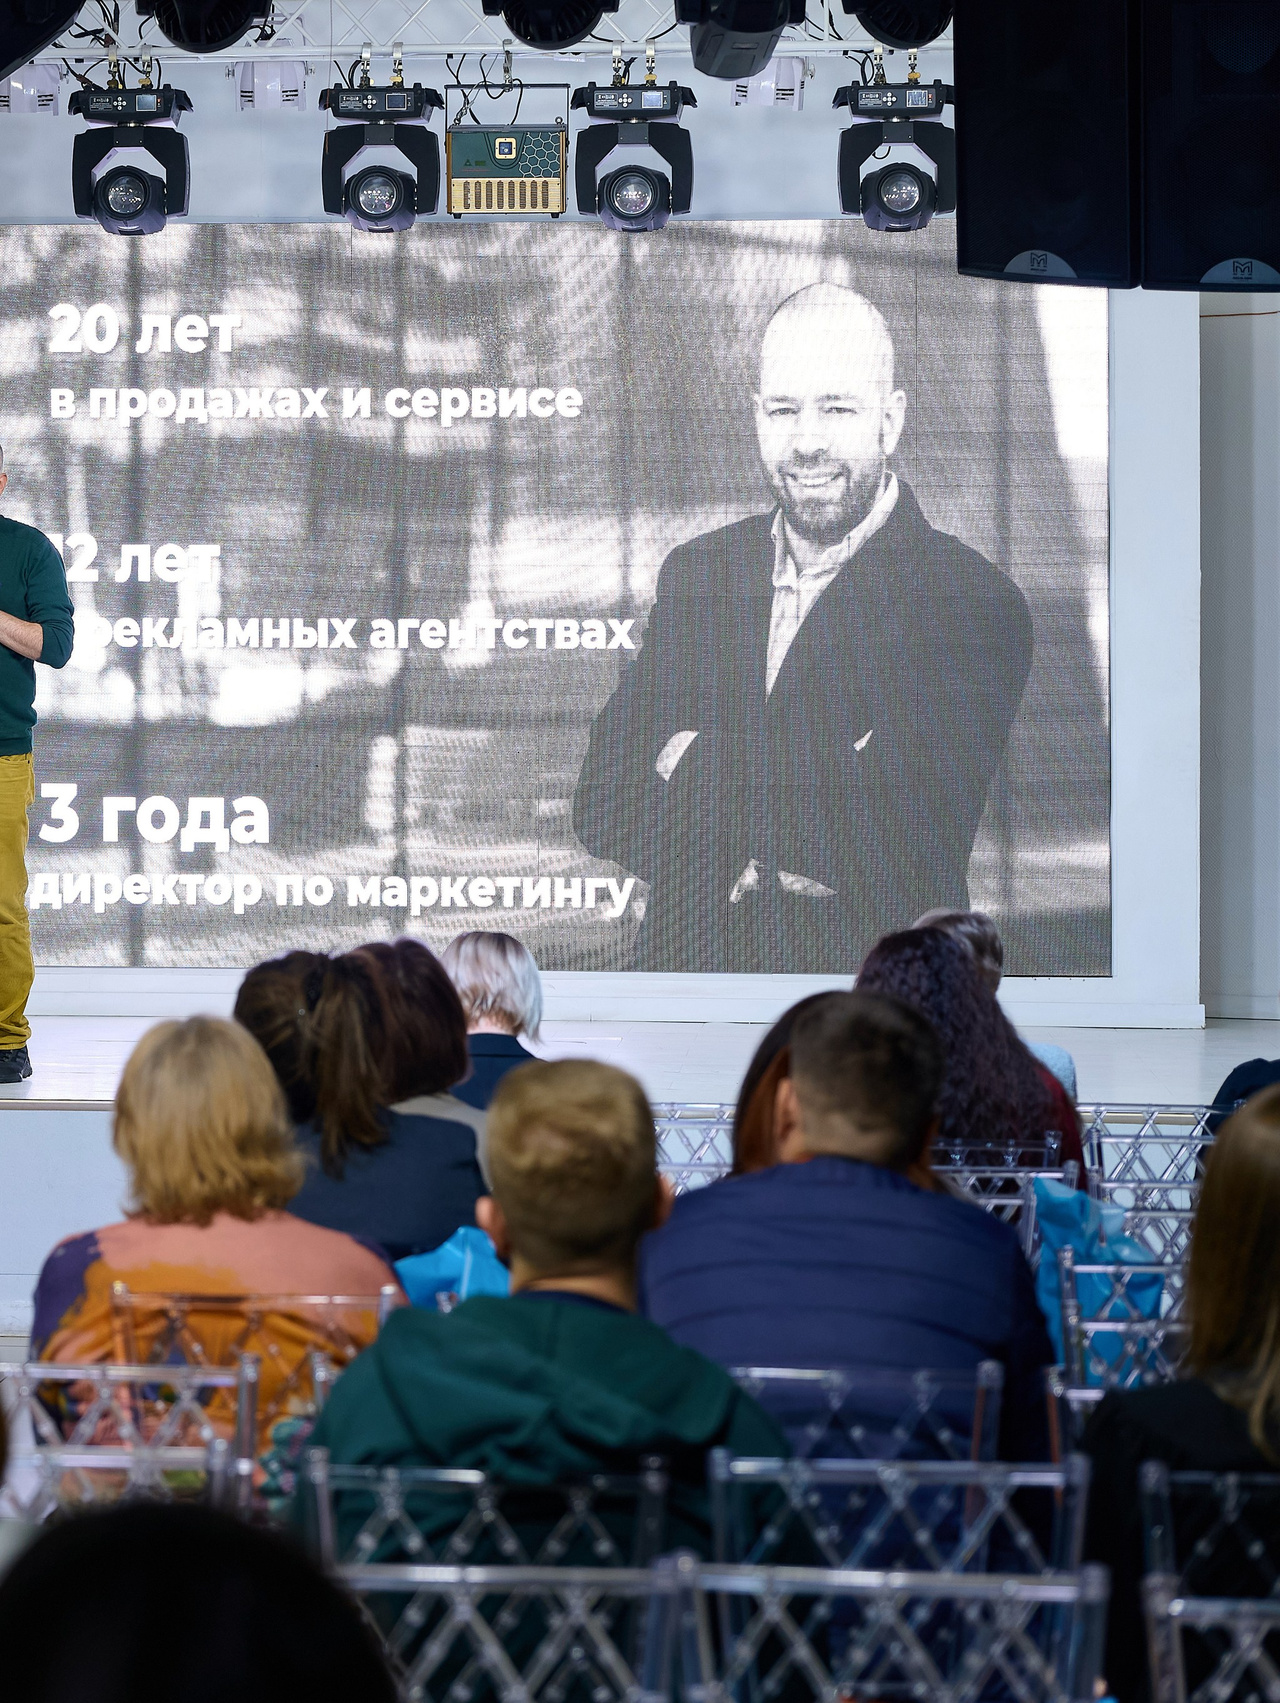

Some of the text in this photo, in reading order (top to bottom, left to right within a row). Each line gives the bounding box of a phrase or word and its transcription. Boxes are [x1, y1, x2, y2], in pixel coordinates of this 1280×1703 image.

[47, 303, 242, 353] 20 лет
[50, 386, 583, 428] в продажах и сервисе
[47, 533, 221, 583] 2 лет
[370, 614, 635, 650] агентствах
[37, 782, 270, 852] 3 года
[29, 872, 635, 916] директор по маркетингу
